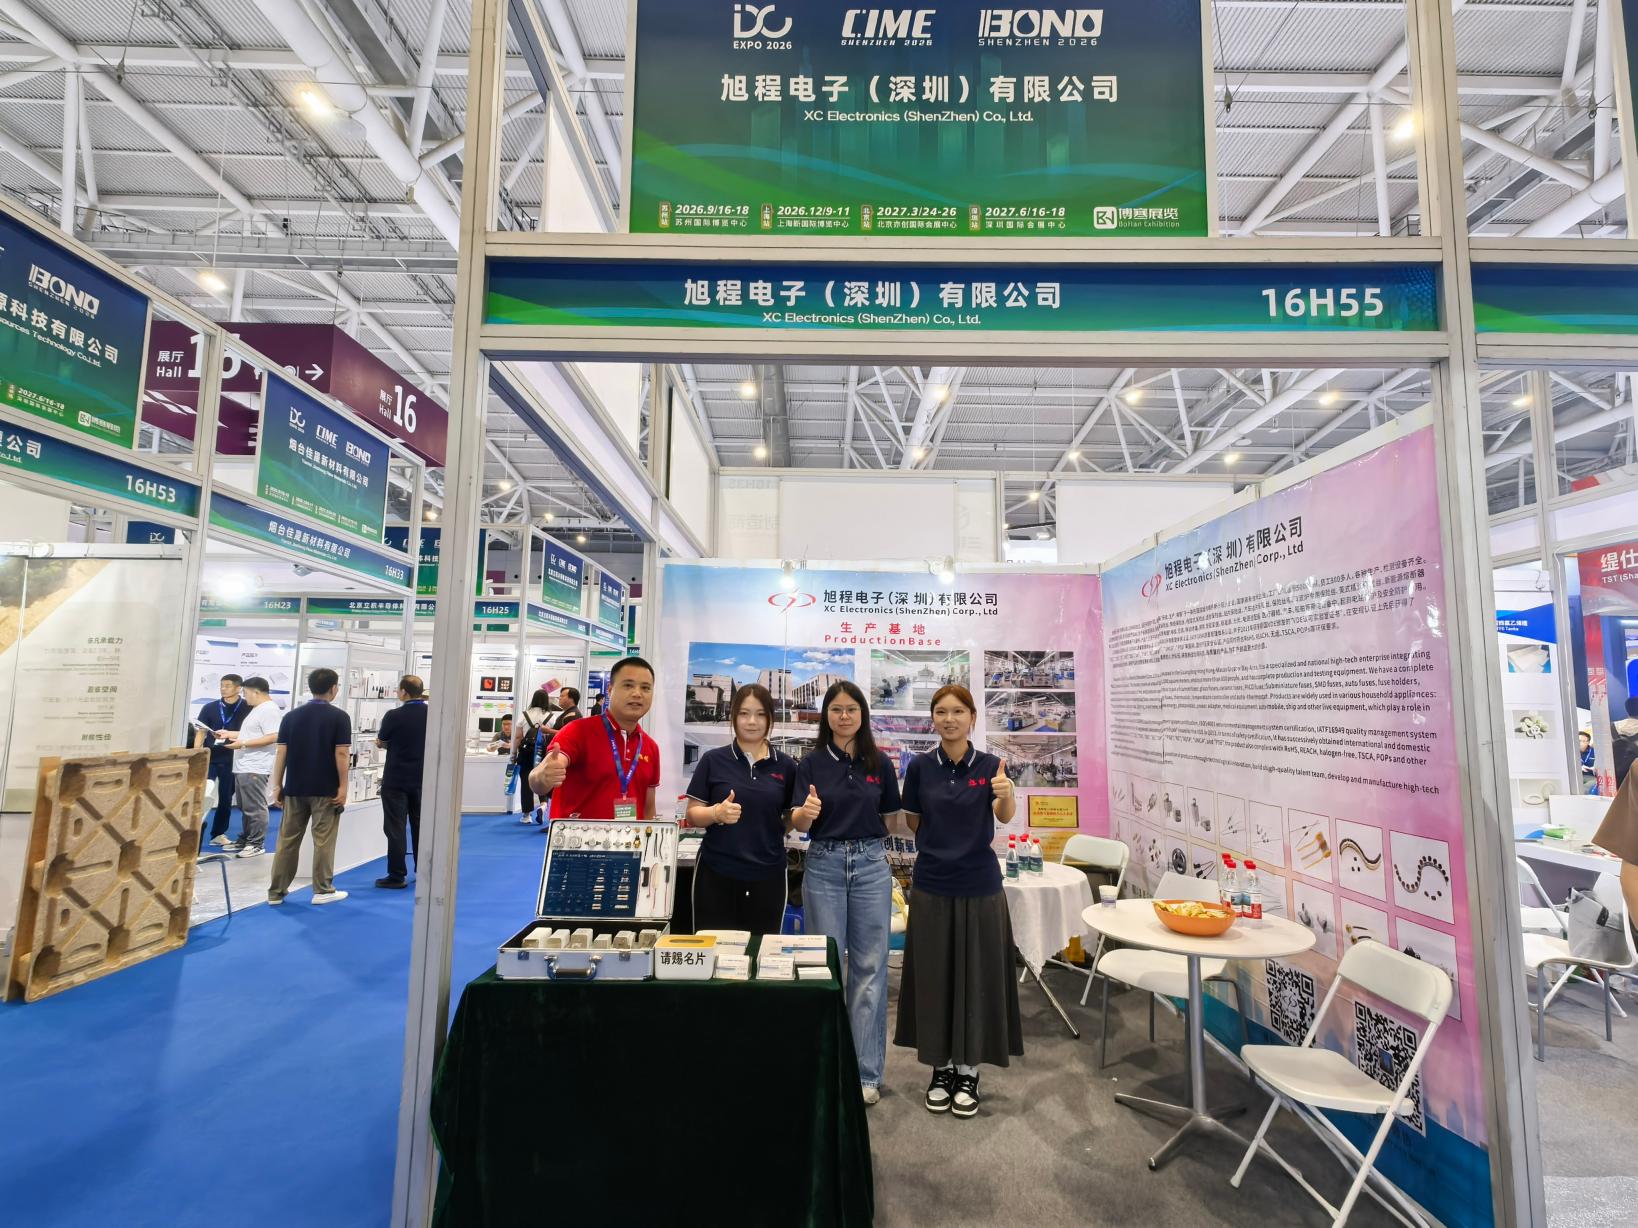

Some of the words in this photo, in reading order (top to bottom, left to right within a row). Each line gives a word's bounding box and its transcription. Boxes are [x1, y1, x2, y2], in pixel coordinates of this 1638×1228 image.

[733, 41, 762, 50] EXPO
[766, 41, 792, 50] 2026
[979, 38, 1050, 46] SHENZHEN
[1058, 38, 1098, 46] 2026
[720, 73, 1119, 103] 旭程电子（深圳）有限公司
[804, 111, 824, 122] XC
[828, 111, 900, 122] Electronics
[903, 110, 980, 122] (ShenZhen)
[983, 111, 1007, 122] Co.,
[1010, 111, 1034, 121] Ltd.
[675, 204, 749, 215] 2026.9/16-18
[777, 206, 850, 216] 2026.12/9-11
[876, 207, 957, 216] 2027.3/24-26
[985, 207, 1066, 217] 2027.6/16-18
[684, 279, 1062, 309] 旭程电子（深圳）有限公司
[1261, 287, 1384, 317] 16H55
[762, 313, 782, 325] XC
[786, 312, 855, 324] Electronics
[858, 312, 930, 325] (ShenZhen)
[933, 312, 956, 325] Co.,
[958, 312, 982, 324] Ltd.
[33, 330, 76, 357] Technology
[157, 351, 184, 363] 展厅
[156, 366, 182, 378] Hall
[379, 389, 393, 406] 展厅
[379, 404, 391, 421] Hall
[393, 385, 417, 434] 16
[125, 475, 176, 503] 16H53
[385, 564, 404, 580] 16H33
[1165, 581, 1173, 591] XC
[1175, 571, 1213, 589] Electronics
[1287, 541, 1304, 556] Ltd
[1601, 574, 1618, 584] TST
[264, 601, 291, 609] 16H23
[823, 590, 999, 607] 旭程电子(深圳)有限公司
[482, 606, 509, 615] 16H25
[824, 606, 836, 614] XC
[840, 606, 894, 615] Electronics
[895, 606, 951, 617] (ShenZhen)
[983, 607, 998, 616] Ltd
[839, 622, 926, 635] 生产基地
[824, 634, 942, 646] ProductionBase
[1270, 661, 1296, 669] specialized
[1308, 657, 1330, 666] national
[1331, 656, 1357, 665] high-tech
[1359, 654, 1390, 662] enterprise
[1276, 671, 1302, 680] production
[1314, 669, 1332, 677] testing
[1334, 668, 1367, 676] equipment.
[1399, 663, 1434, 673] complete
[1333, 704, 1367, 712] equipment,
[1387, 704, 1400, 712] play
[1346, 727, 1367, 736] quality
[1368, 729, 1409, 738] management
[1410, 731, 1437, 740] system
[1319, 737, 1343, 746] obtained
[1344, 738, 1383, 748] international
[1384, 742, 1395, 750] and
[1397, 743, 1430, 752] domestic
[1358, 752, 1375, 762] TSCA,
[1376, 754, 1392, 762] POPs
[1393, 755, 1405, 763] and
[1407, 757, 1427, 765] other
[1296, 768, 1311, 776] talent
[1328, 772, 1349, 782] develop
[1363, 778, 1403, 790] manufacture
[1404, 781, 1440, 794] high-tech
[660, 951, 707, 966] 请赐名片
